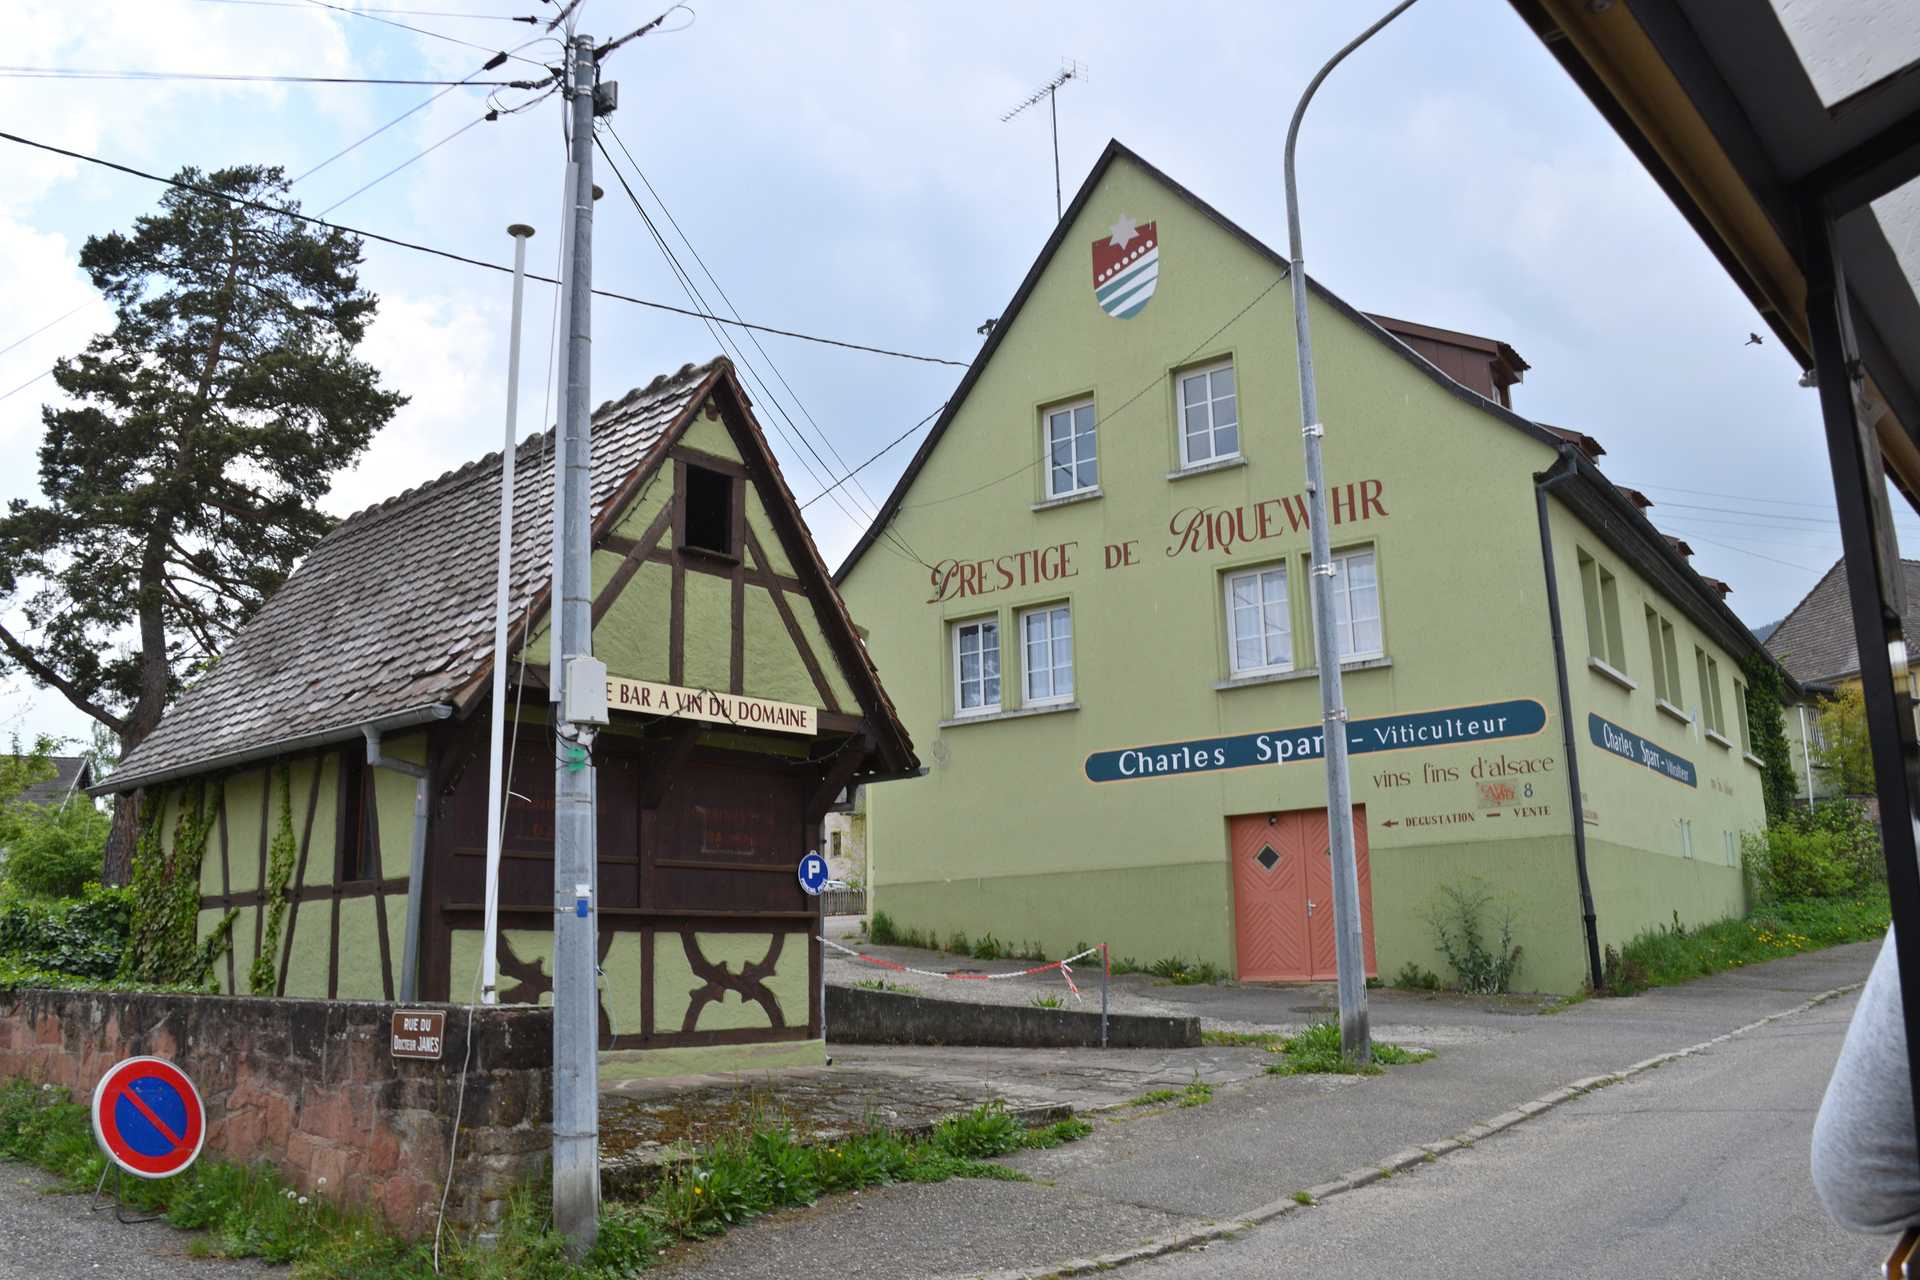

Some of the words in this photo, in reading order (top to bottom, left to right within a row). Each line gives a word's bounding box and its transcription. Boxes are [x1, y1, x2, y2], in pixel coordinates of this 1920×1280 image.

[926, 542, 1079, 604] PRESTIGE
[1104, 540, 1141, 570] DE
[1166, 479, 1390, 558] RIQUEWHR
[606, 682, 613, 701] E
[620, 683, 650, 707] BAR
[659, 690, 670, 709] A
[676, 692, 703, 714] VIN
[709, 697, 732, 718] DU
[738, 701, 808, 728] DOMAINE
[1118, 747, 1225, 775] Charles
[1256, 735, 1324, 765] Spar
[1374, 717, 1508, 745] Viticulteur
[1603, 723, 1634, 758] Charles
[1373, 770, 1411, 789] vins
[1424, 763, 1460, 784] fins
[1470, 754, 1554, 779] d'alsace
[1523, 783, 1534, 799] 8
[1513, 806, 1551, 817] VENTE
[808, 860, 819, 880] P
[403, 1017, 419, 1031] RUE
[420, 1018, 431, 1031] DU
